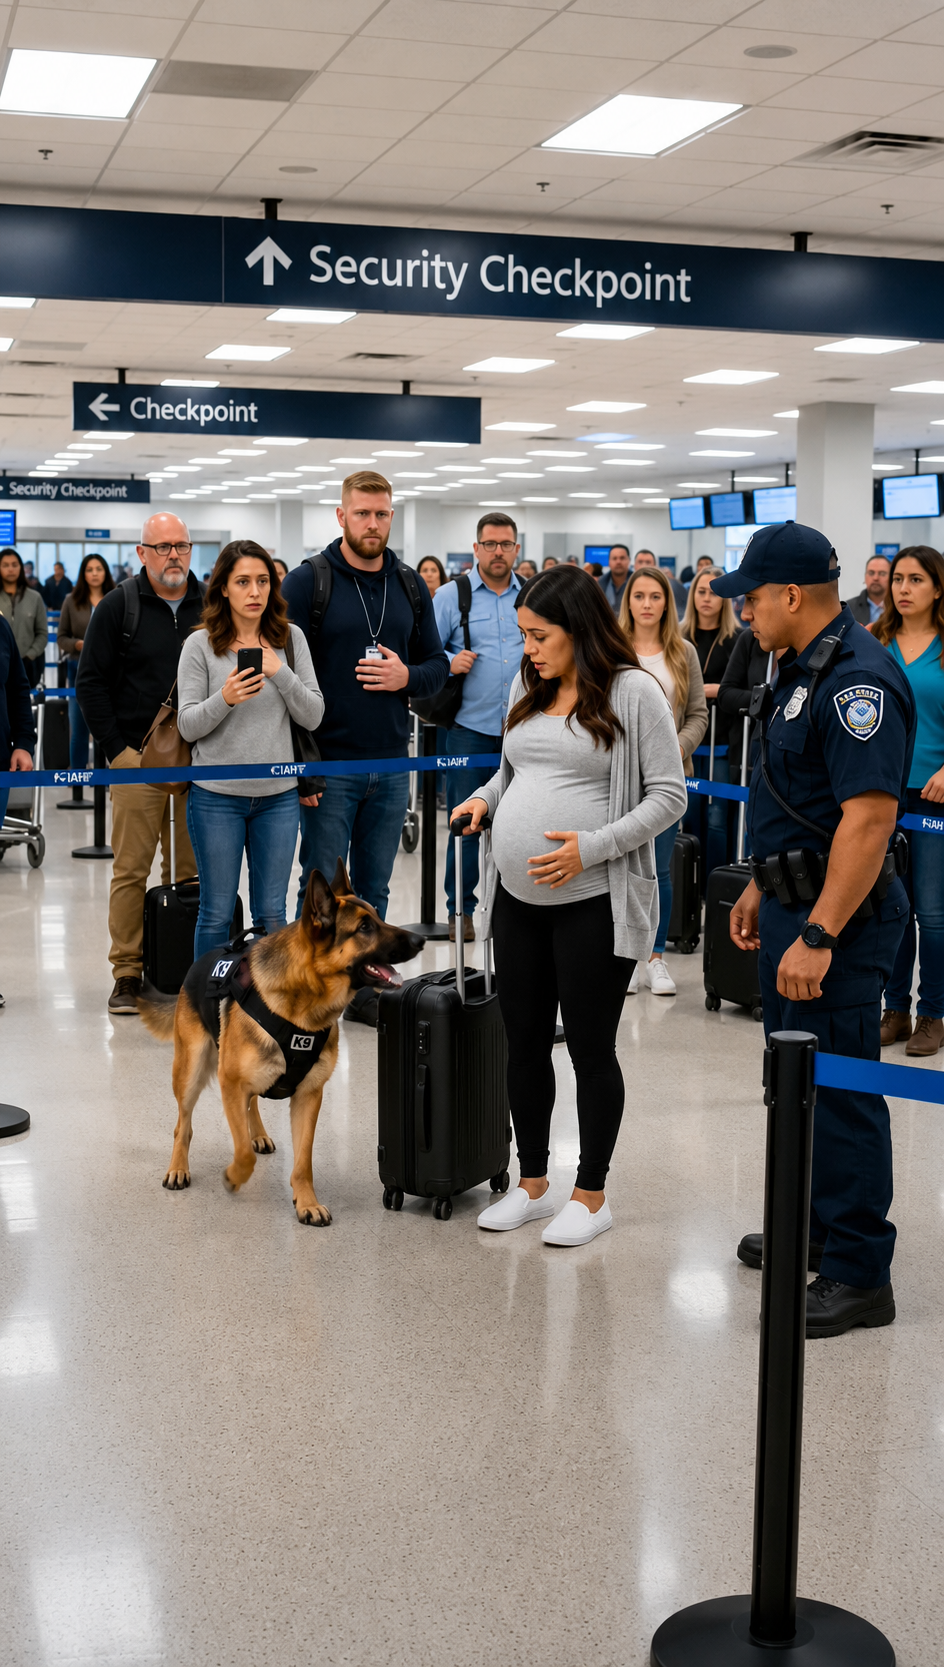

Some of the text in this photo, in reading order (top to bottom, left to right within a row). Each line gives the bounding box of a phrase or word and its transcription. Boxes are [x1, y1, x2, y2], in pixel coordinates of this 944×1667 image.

[309, 244, 692, 309] Security Checkpoint
[129, 396, 259, 427] Checkpoint
[9, 481, 128, 501] Security Checkpoint
[211, 959, 234, 978] K9
[292, 1036, 313, 1050] K9
